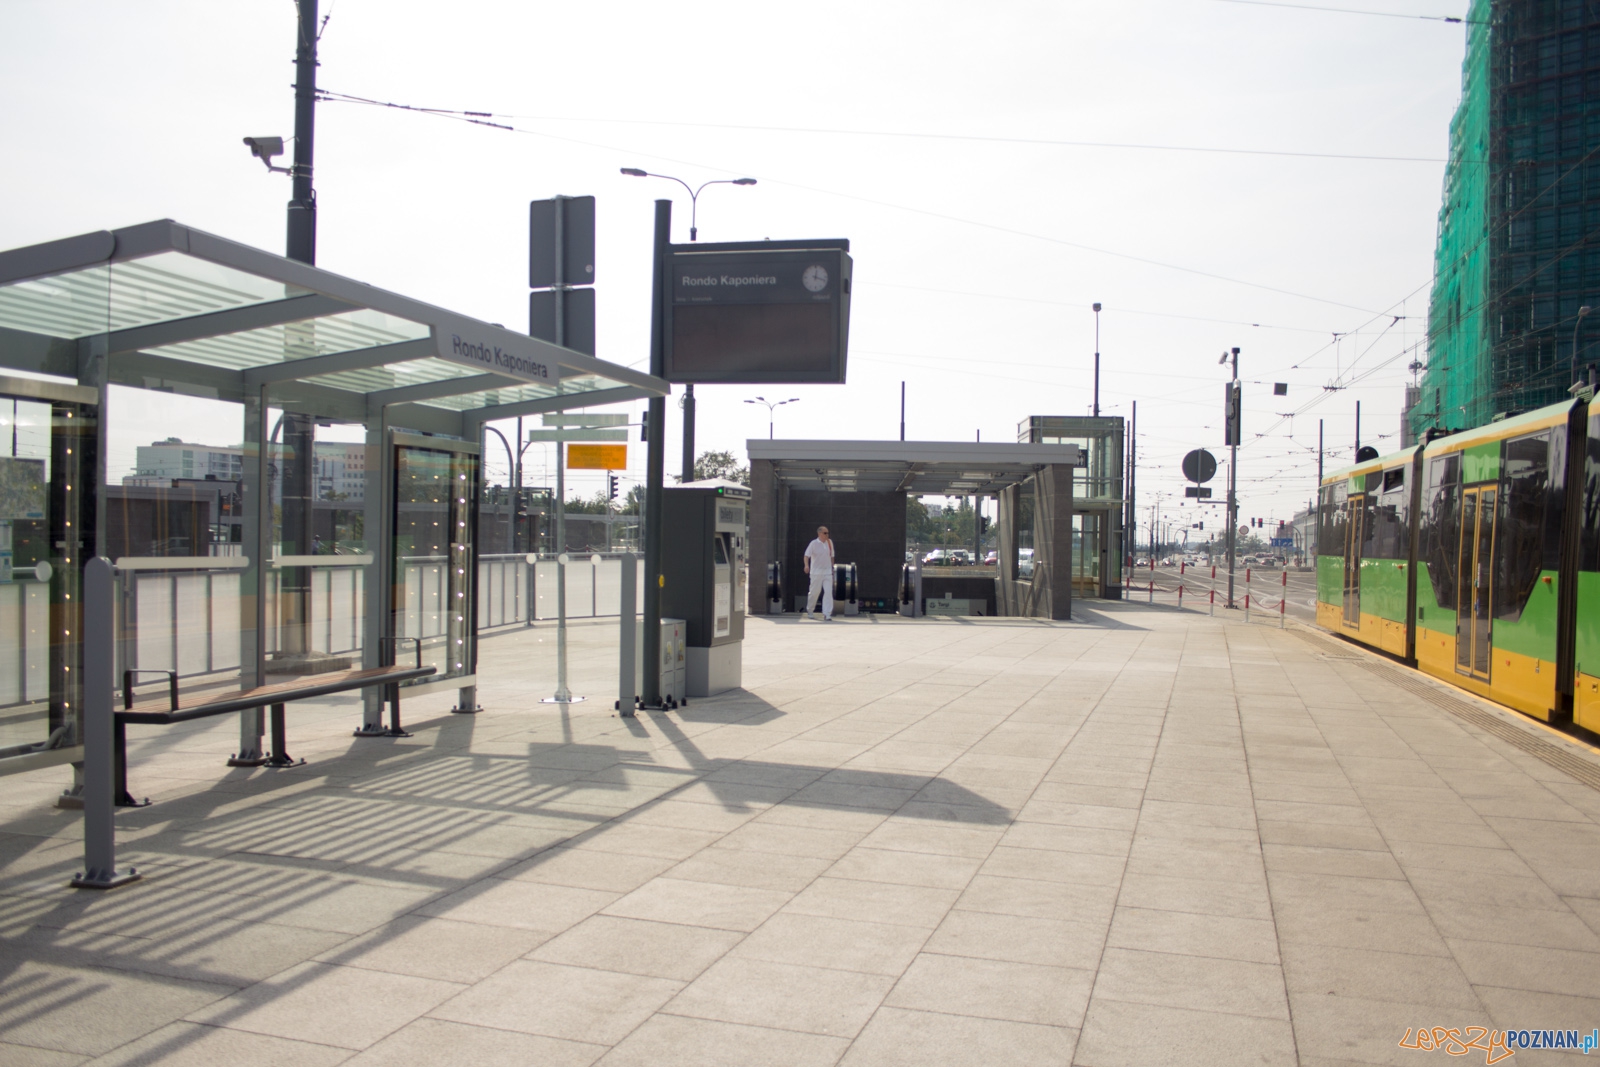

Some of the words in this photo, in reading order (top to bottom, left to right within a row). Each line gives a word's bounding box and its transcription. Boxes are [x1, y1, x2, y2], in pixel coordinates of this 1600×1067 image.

[682, 275, 717, 286] Rondo
[720, 274, 776, 287] Kaponiera
[452, 334, 491, 363] Rondo
[494, 346, 548, 378] Kaponiera
